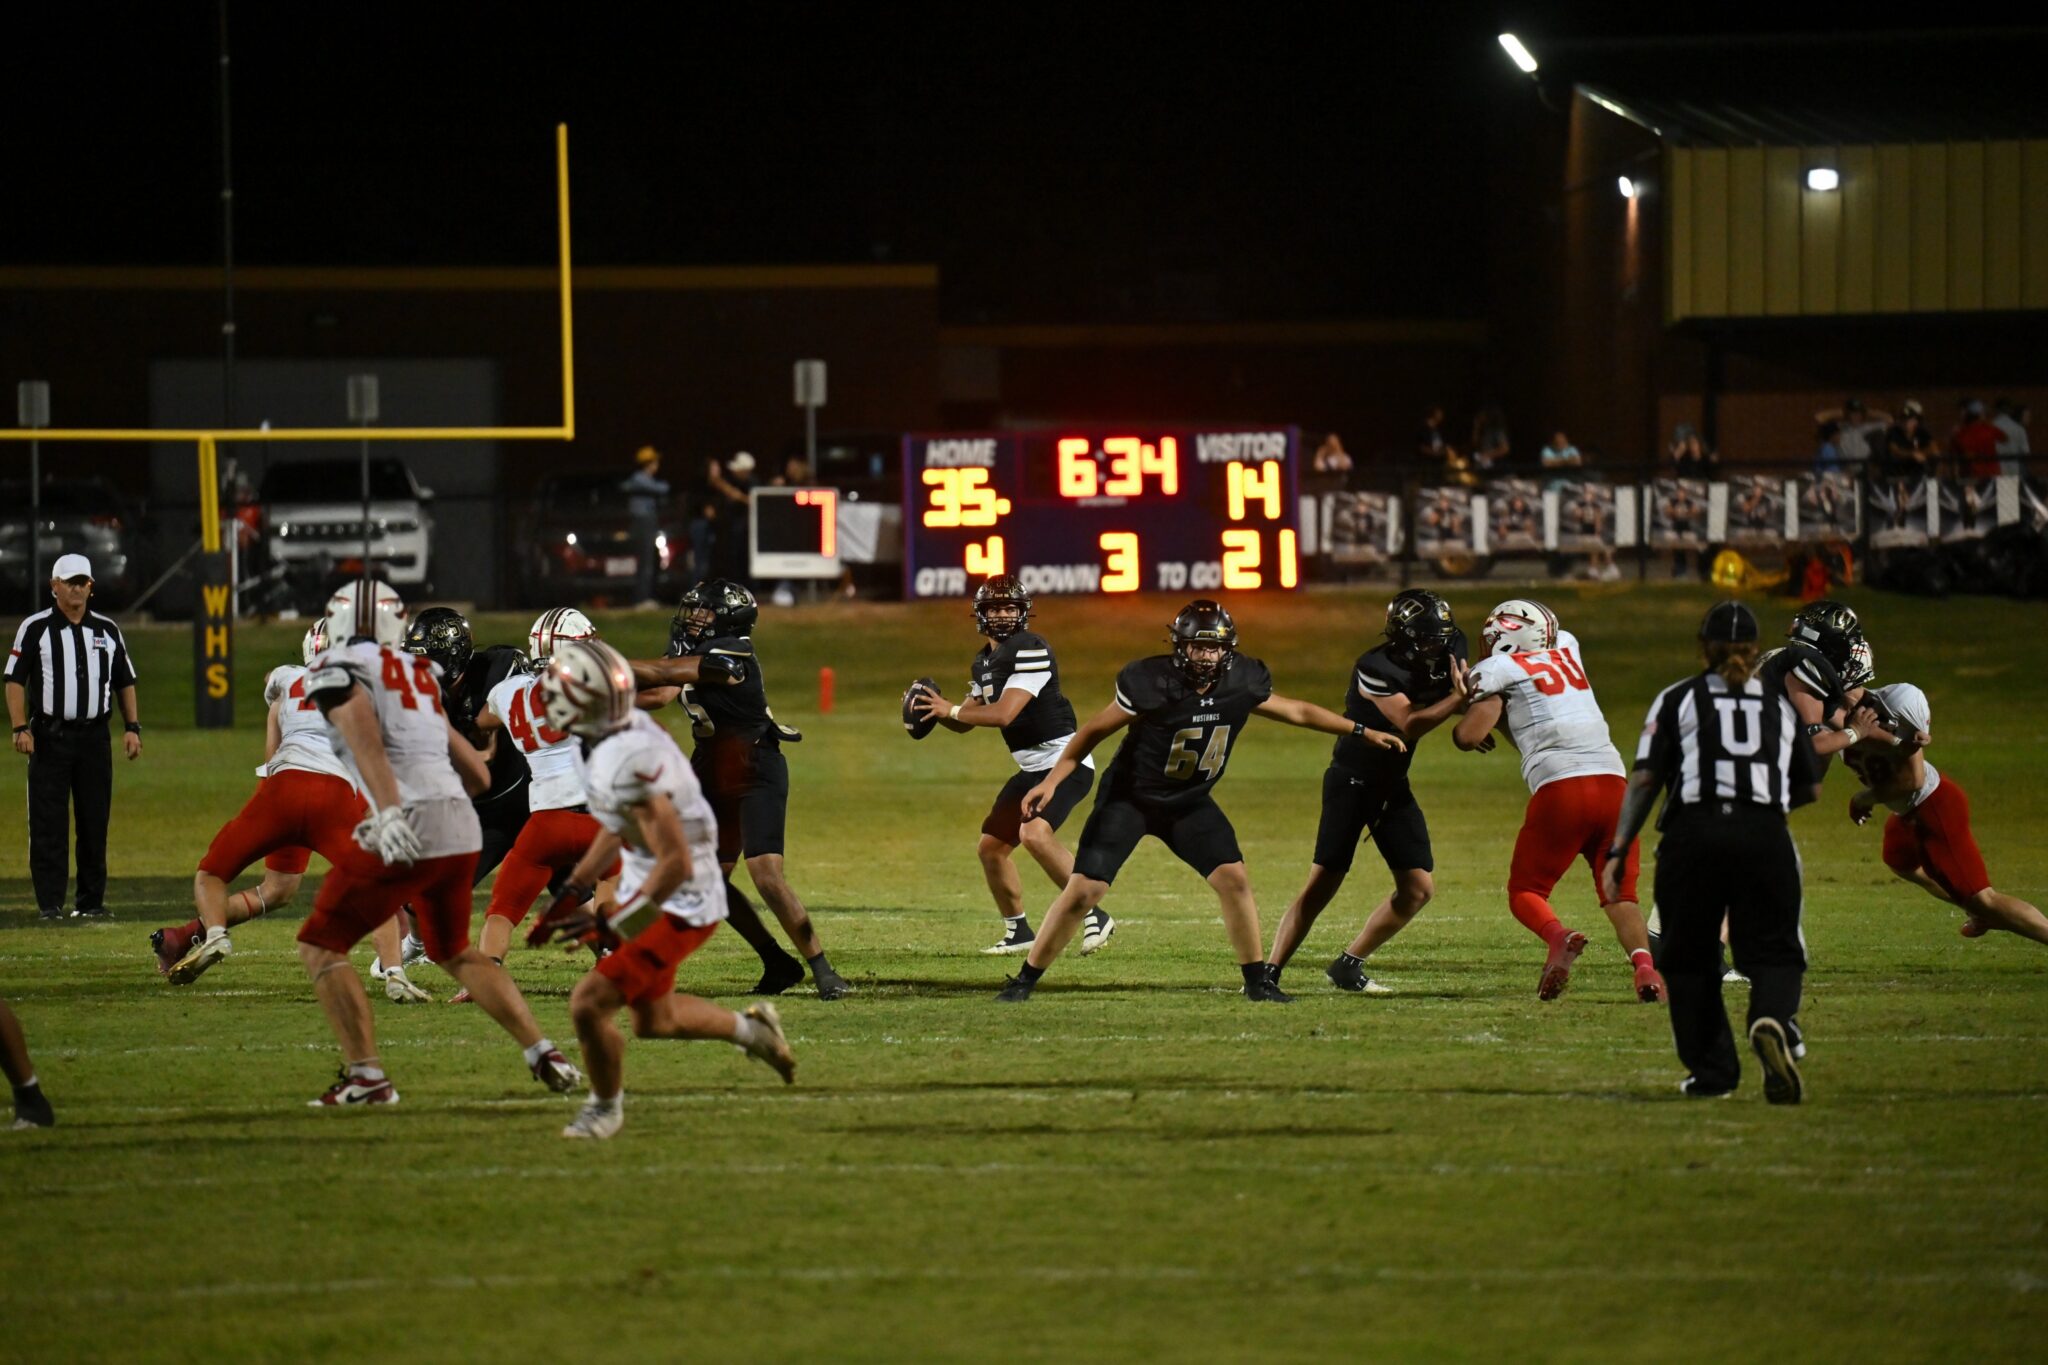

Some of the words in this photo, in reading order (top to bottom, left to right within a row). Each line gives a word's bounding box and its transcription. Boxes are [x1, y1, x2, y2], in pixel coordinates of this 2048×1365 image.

[926, 439, 997, 468] HOME
[1196, 433, 1286, 462] VISITOR
[1226, 460, 1281, 520] 14
[914, 566, 966, 596] QTR
[965, 536, 1004, 580] 4
[1019, 564, 1100, 594] DOWN
[1100, 532, 1139, 592] 3
[1157, 562, 1186, 589] TO
[1190, 561, 1222, 588] GO
[1222, 528, 1297, 590] 21
[379, 644, 443, 715] 44
[1713, 698, 1764, 756] U
[1164, 724, 1231, 781] 64
